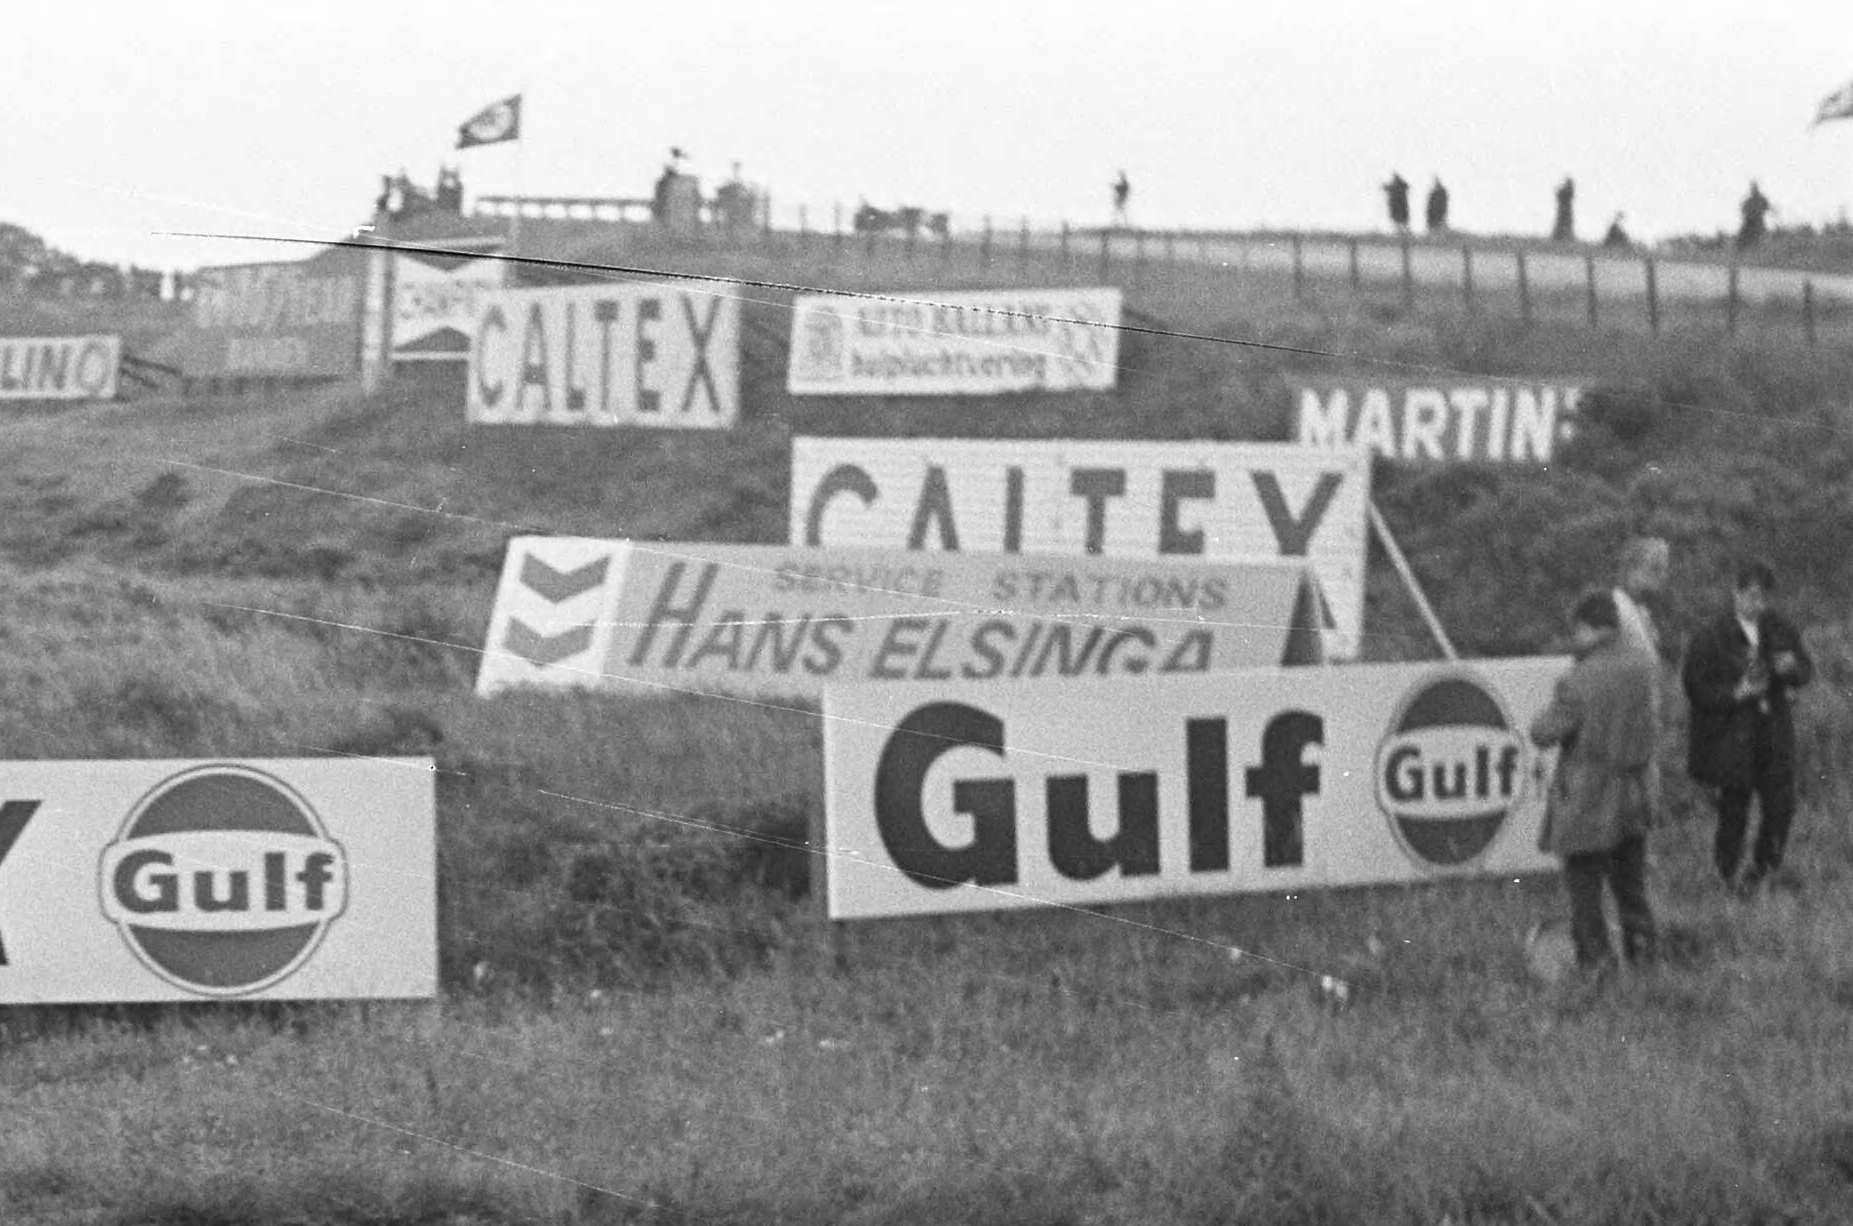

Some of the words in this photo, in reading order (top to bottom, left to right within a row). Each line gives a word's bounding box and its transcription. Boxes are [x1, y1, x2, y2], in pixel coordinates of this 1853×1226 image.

[477, 294, 721, 413] CALTEX
[628, 562, 855, 676] HANS
[774, 560, 946, 596] SERVICE
[994, 567, 1229, 609] STATIONS
[873, 697, 1326, 891] Gulf
[1382, 744, 1518, 804] Gulf
[112, 847, 335, 914] Gulf
